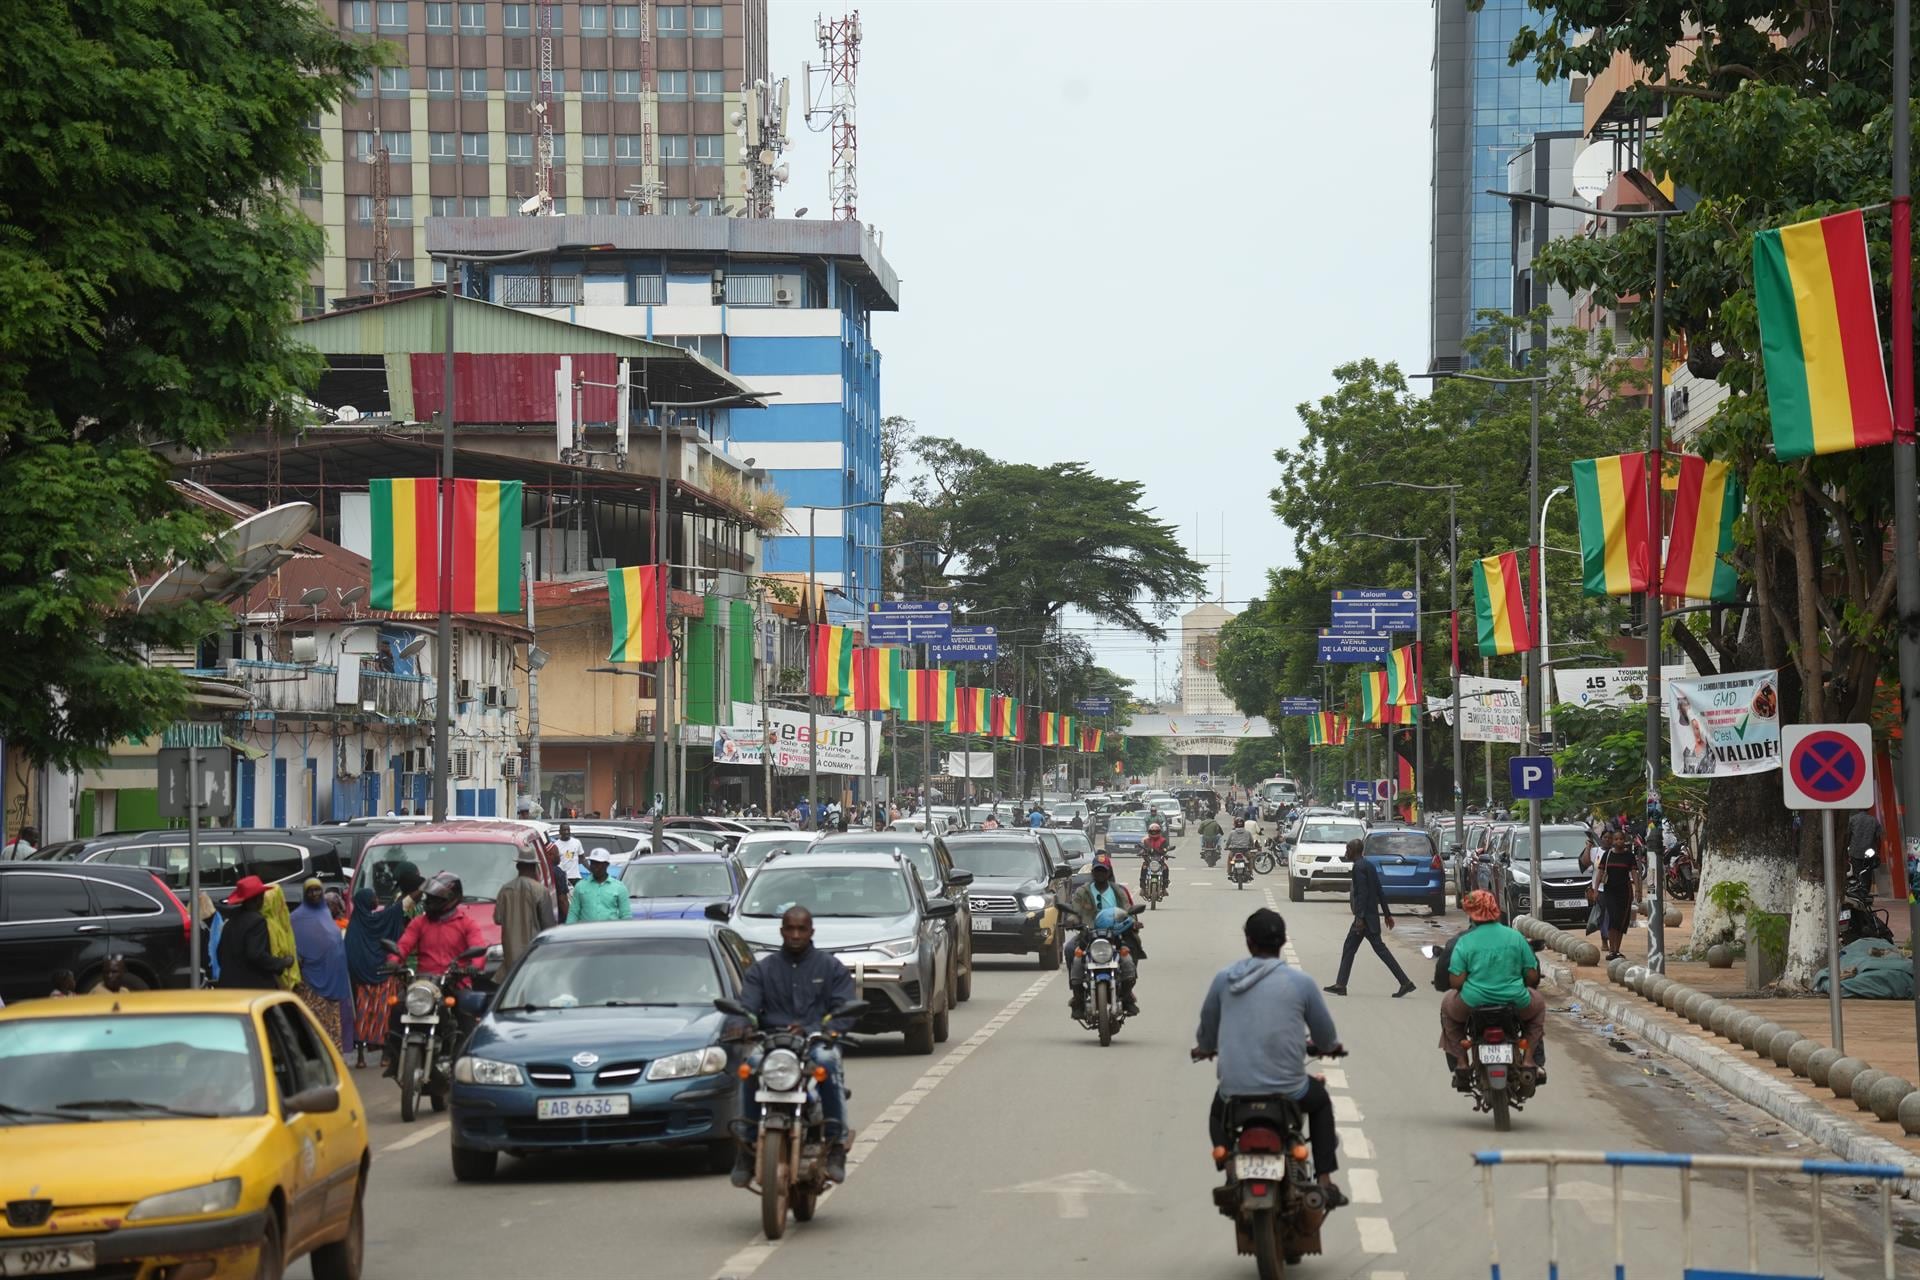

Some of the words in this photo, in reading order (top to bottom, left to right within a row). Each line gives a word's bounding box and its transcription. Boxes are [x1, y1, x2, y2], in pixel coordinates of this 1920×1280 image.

[1586, 676, 1606, 688] 15
[1713, 692, 1736, 708] GMD
[1714, 730, 1732, 742] C'est
[823, 760, 853, 769] CONAKRY
[1523, 766, 1542, 790] P
[551, 1101, 569, 1116] AB
[575, 1099, 612, 1114] 6636
[22, 1248, 70, 1271] 9973
